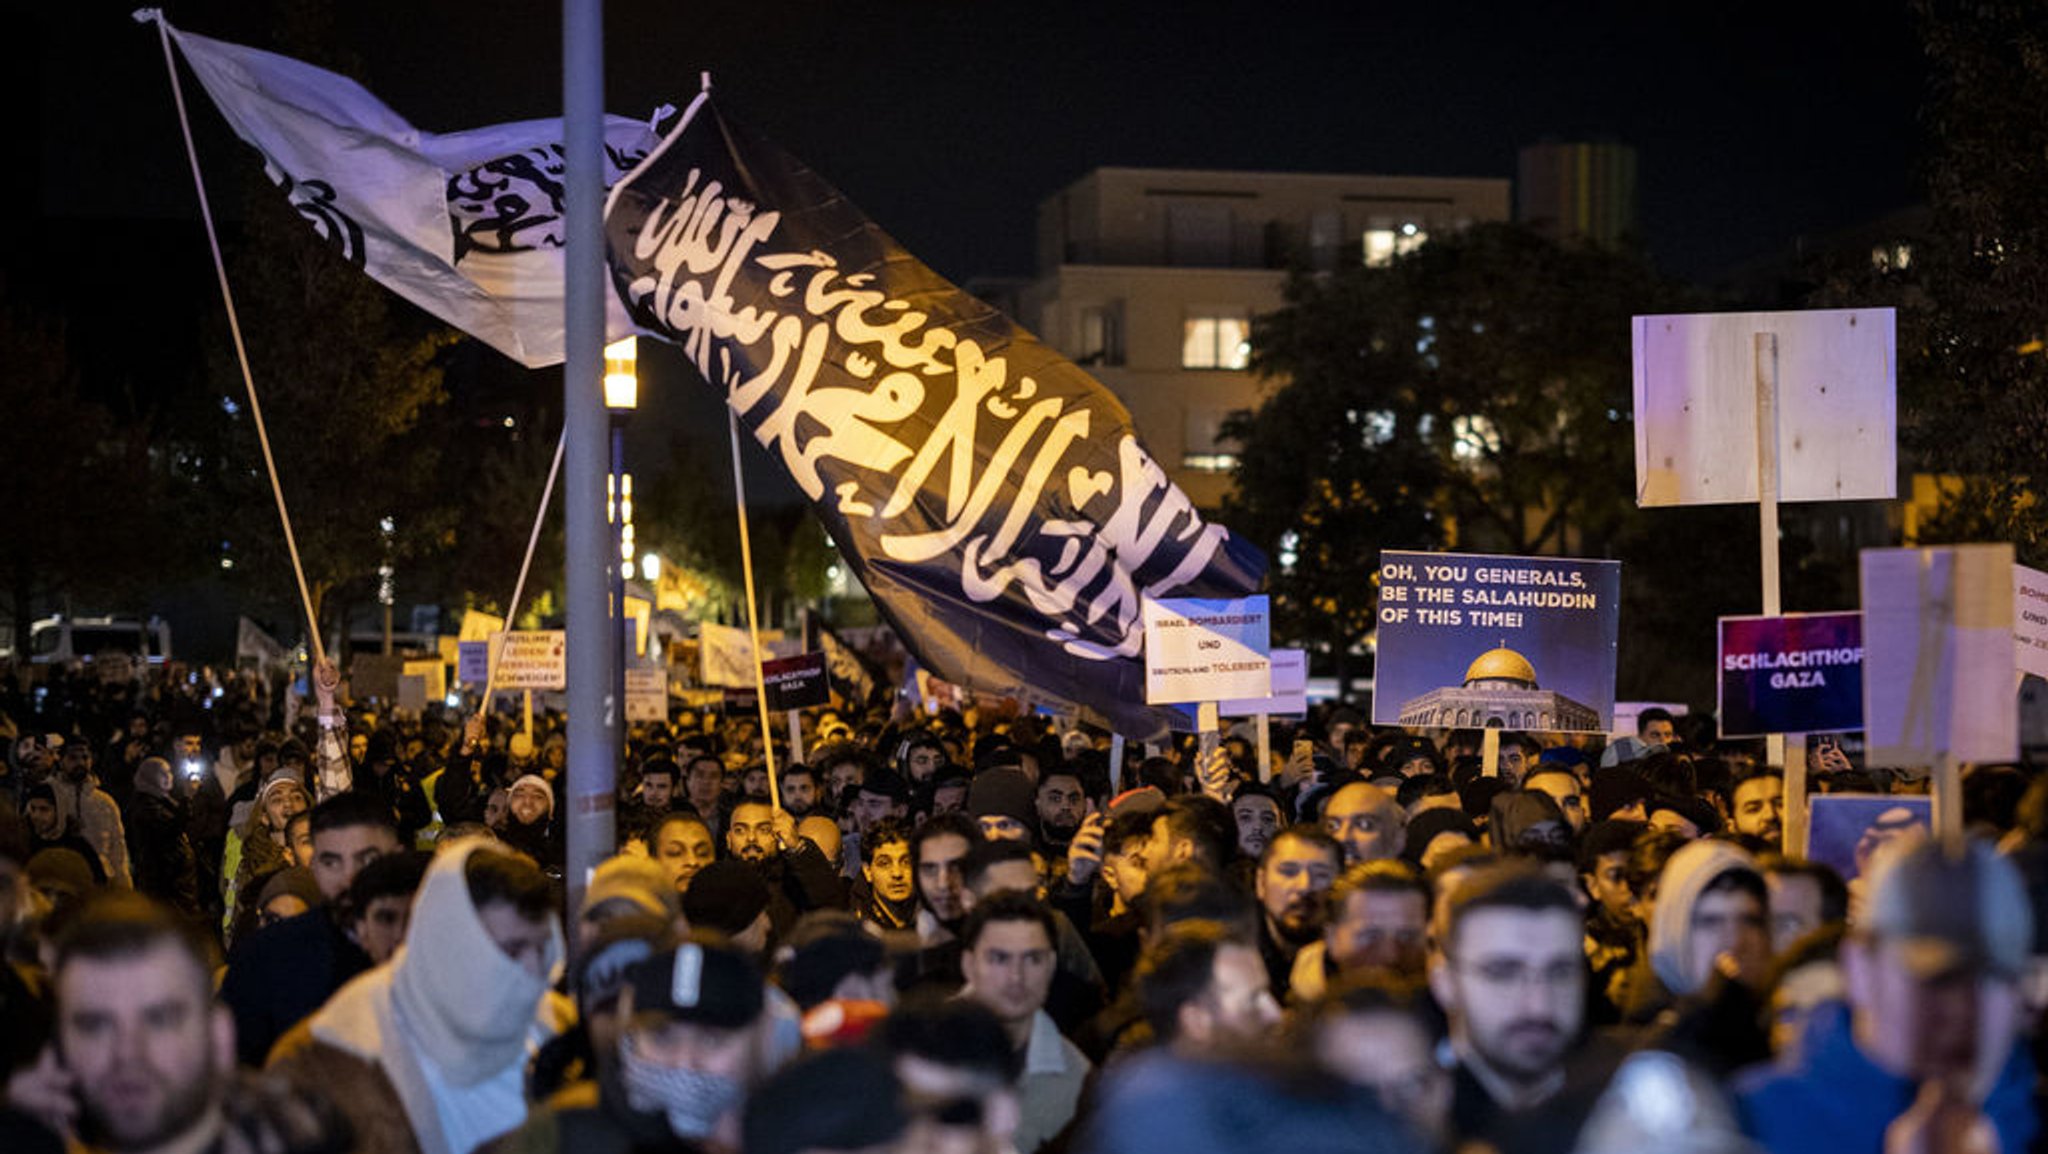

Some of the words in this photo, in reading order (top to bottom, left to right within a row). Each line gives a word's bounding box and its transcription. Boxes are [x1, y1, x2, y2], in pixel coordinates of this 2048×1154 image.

[1382, 564, 1417, 582] OH,
[1425, 565, 1468, 582] YOU
[1474, 568, 1587, 589] GENERALS,
[1382, 586, 1408, 602] BE
[1415, 587, 1455, 604] THE
[1462, 589, 1596, 610] SALAHUDDIN
[1155, 618, 1185, 628] ISRAEL
[1188, 614, 1262, 628] BOMBARDIERT
[1380, 607, 1409, 624] OF
[1416, 608, 1462, 626] THIS
[1468, 610, 1524, 629] TIME!
[1198, 639, 1222, 650] UND
[1152, 665, 1210, 676] DEUTSCHLAND
[1212, 661, 1267, 674] TOLERIERT
[1724, 648, 1865, 671] SCHLACHTHOF
[1769, 671, 1826, 689] GAZA
